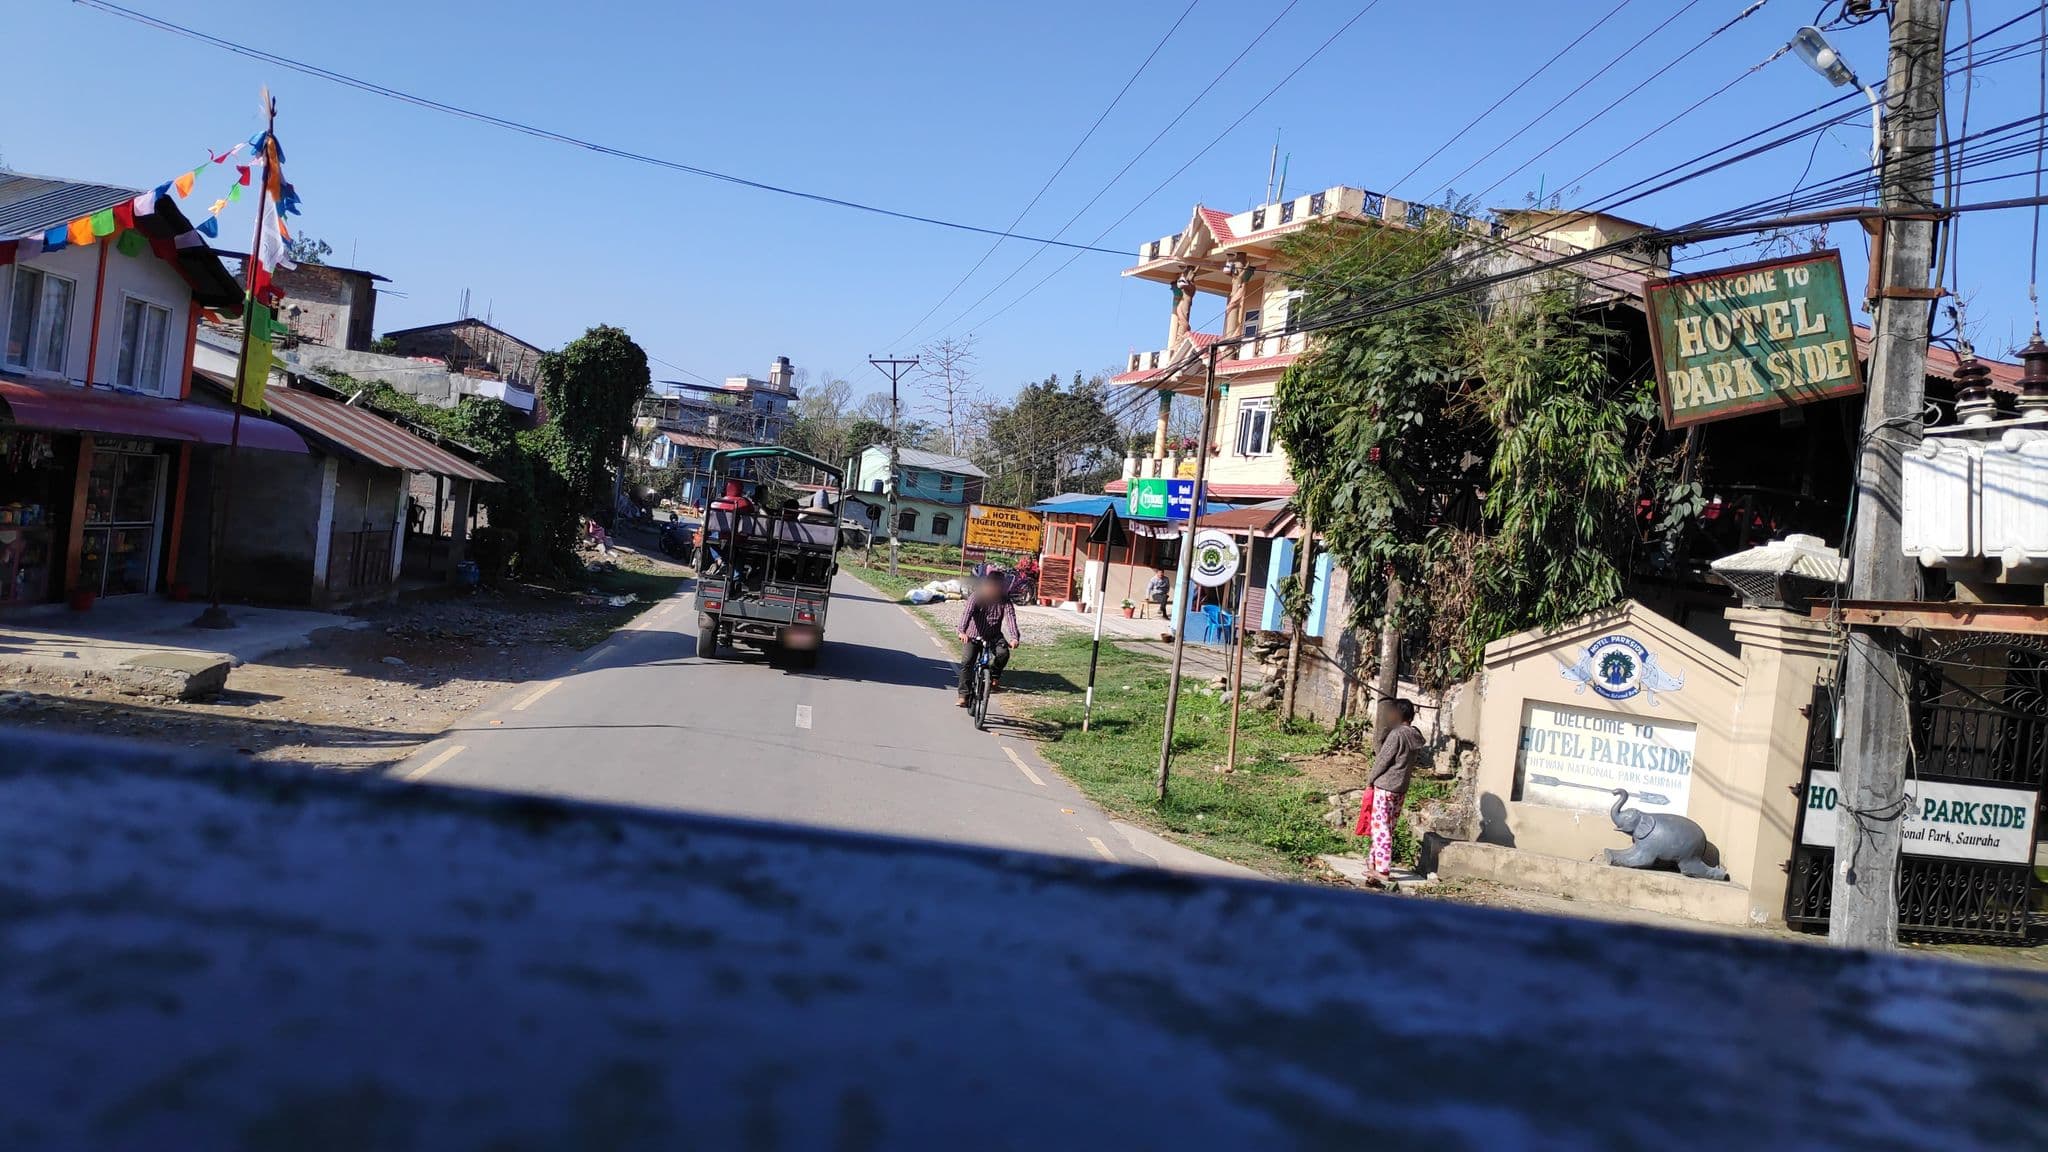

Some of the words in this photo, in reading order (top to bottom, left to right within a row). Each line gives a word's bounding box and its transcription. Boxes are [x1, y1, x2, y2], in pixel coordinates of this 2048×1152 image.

[1685, 271, 1777, 306] WELCOME
[1783, 267, 1810, 288] TO
[1674, 297, 1827, 358] HOTEL
[1667, 356, 1764, 411] PARK
[1766, 340, 1852, 391] SIDE
[971, 517, 996, 526] TIGER
[996, 520, 1026, 529] CORNER
[1026, 523, 1041, 532] INN
[992, 512, 1021, 522] HOTEL
[1589, 638, 1609, 653] HOTEL
[1610, 635, 1645, 655] PARKSIDE
[1553, 711, 1625, 735] WELCOME
[1632, 723, 1654, 739] TO
[1519, 726, 1585, 759] HOTEL
[1589, 737, 1692, 776] PARKSIDE
[1528, 757, 1564, 771] HITWAN
[1567, 762, 1615, 780] NATIONAL
[1617, 771, 1641, 784] PARK
[1921, 797, 2026, 829] PARKSIDE
[1928, 829, 1954, 845] Park,
[1956, 832, 2001, 848] Sauraha
